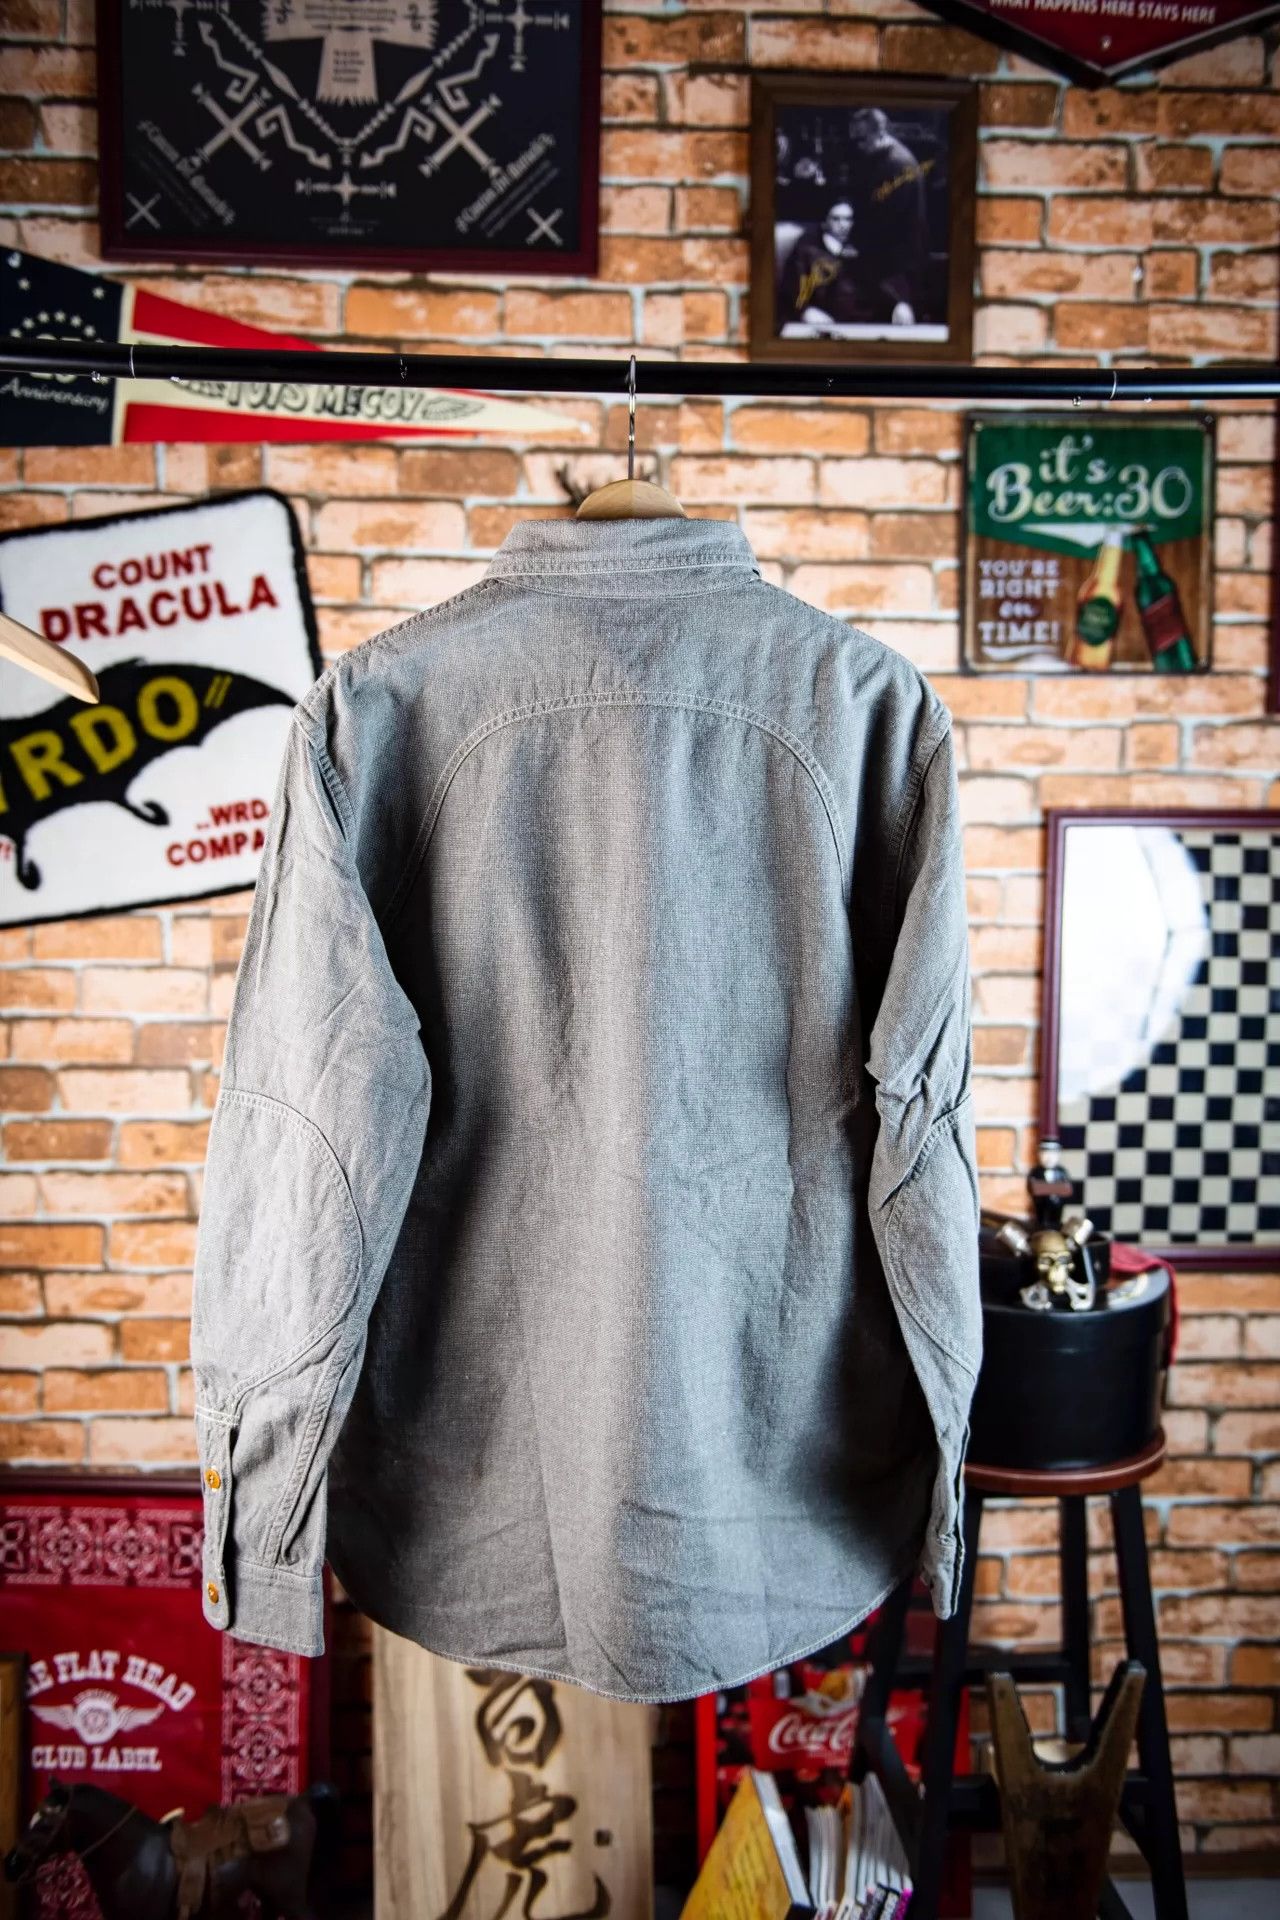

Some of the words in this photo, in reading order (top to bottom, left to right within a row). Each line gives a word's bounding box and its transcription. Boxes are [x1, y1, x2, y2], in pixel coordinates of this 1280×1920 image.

[1100, 1, 1134, 18] HERE
[1137, 3, 1179, 21] STAYS
[1181, 6, 1217, 24] HERE
[1038, 434, 1117, 485] it's
[92, 543, 214, 591] COUNT
[40, 575, 279, 643] DRACULA
[979, 579, 1060, 599] RIGHT
[977, 620, 1060, 643] TIME!
[166, 828, 266, 868] COMPA
[53, 1650, 120, 1684] FLAT
[122, 1655, 196, 1712] HEAD
[31, 1744, 87, 1770] CLUB
[92, 1745, 163, 1772] LABEL
